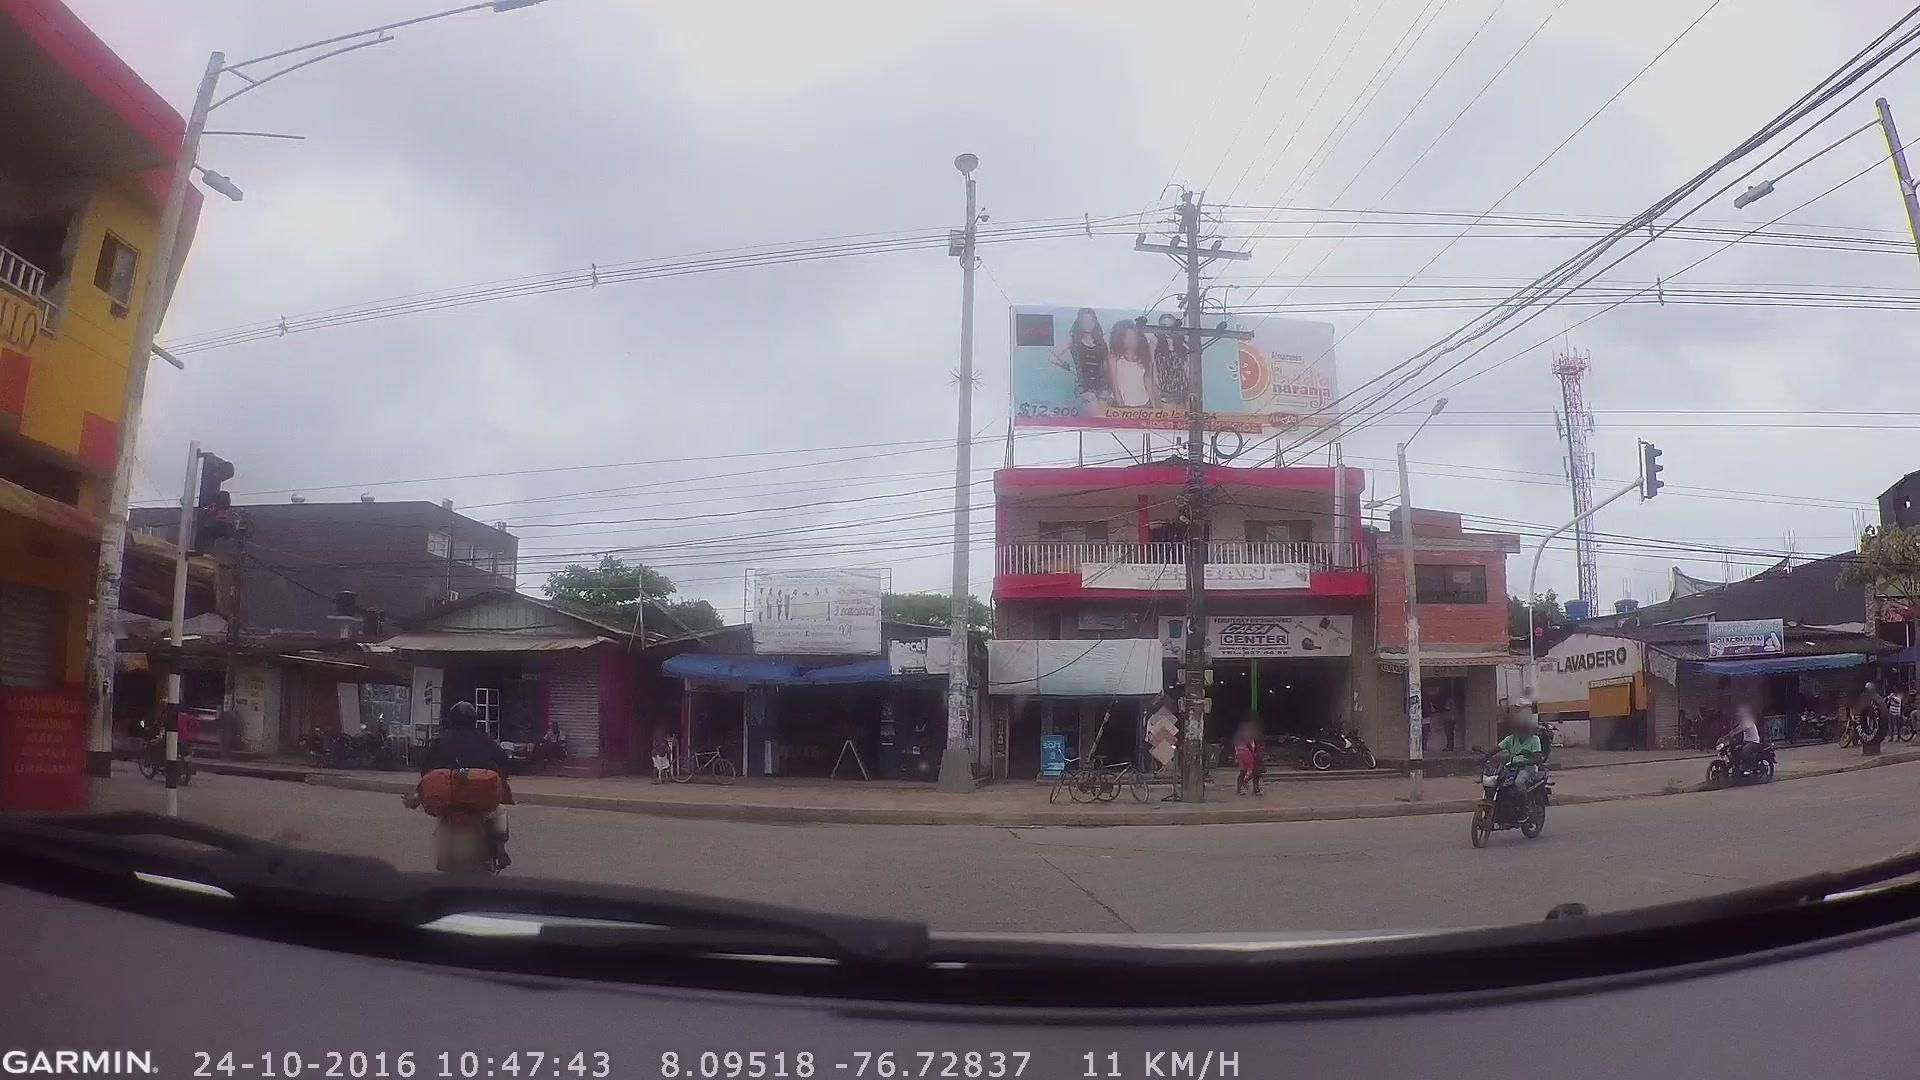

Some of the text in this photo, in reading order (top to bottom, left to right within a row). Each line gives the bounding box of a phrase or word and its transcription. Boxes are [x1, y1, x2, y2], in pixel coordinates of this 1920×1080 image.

[1272, 383, 1331, 408] naranja
[1122, 409, 1153, 420] mejor
[1224, 624, 1275, 633] CASA
[1223, 635, 1286, 644] CENTER
[1557, 646, 1627, 673] LAVADERO
